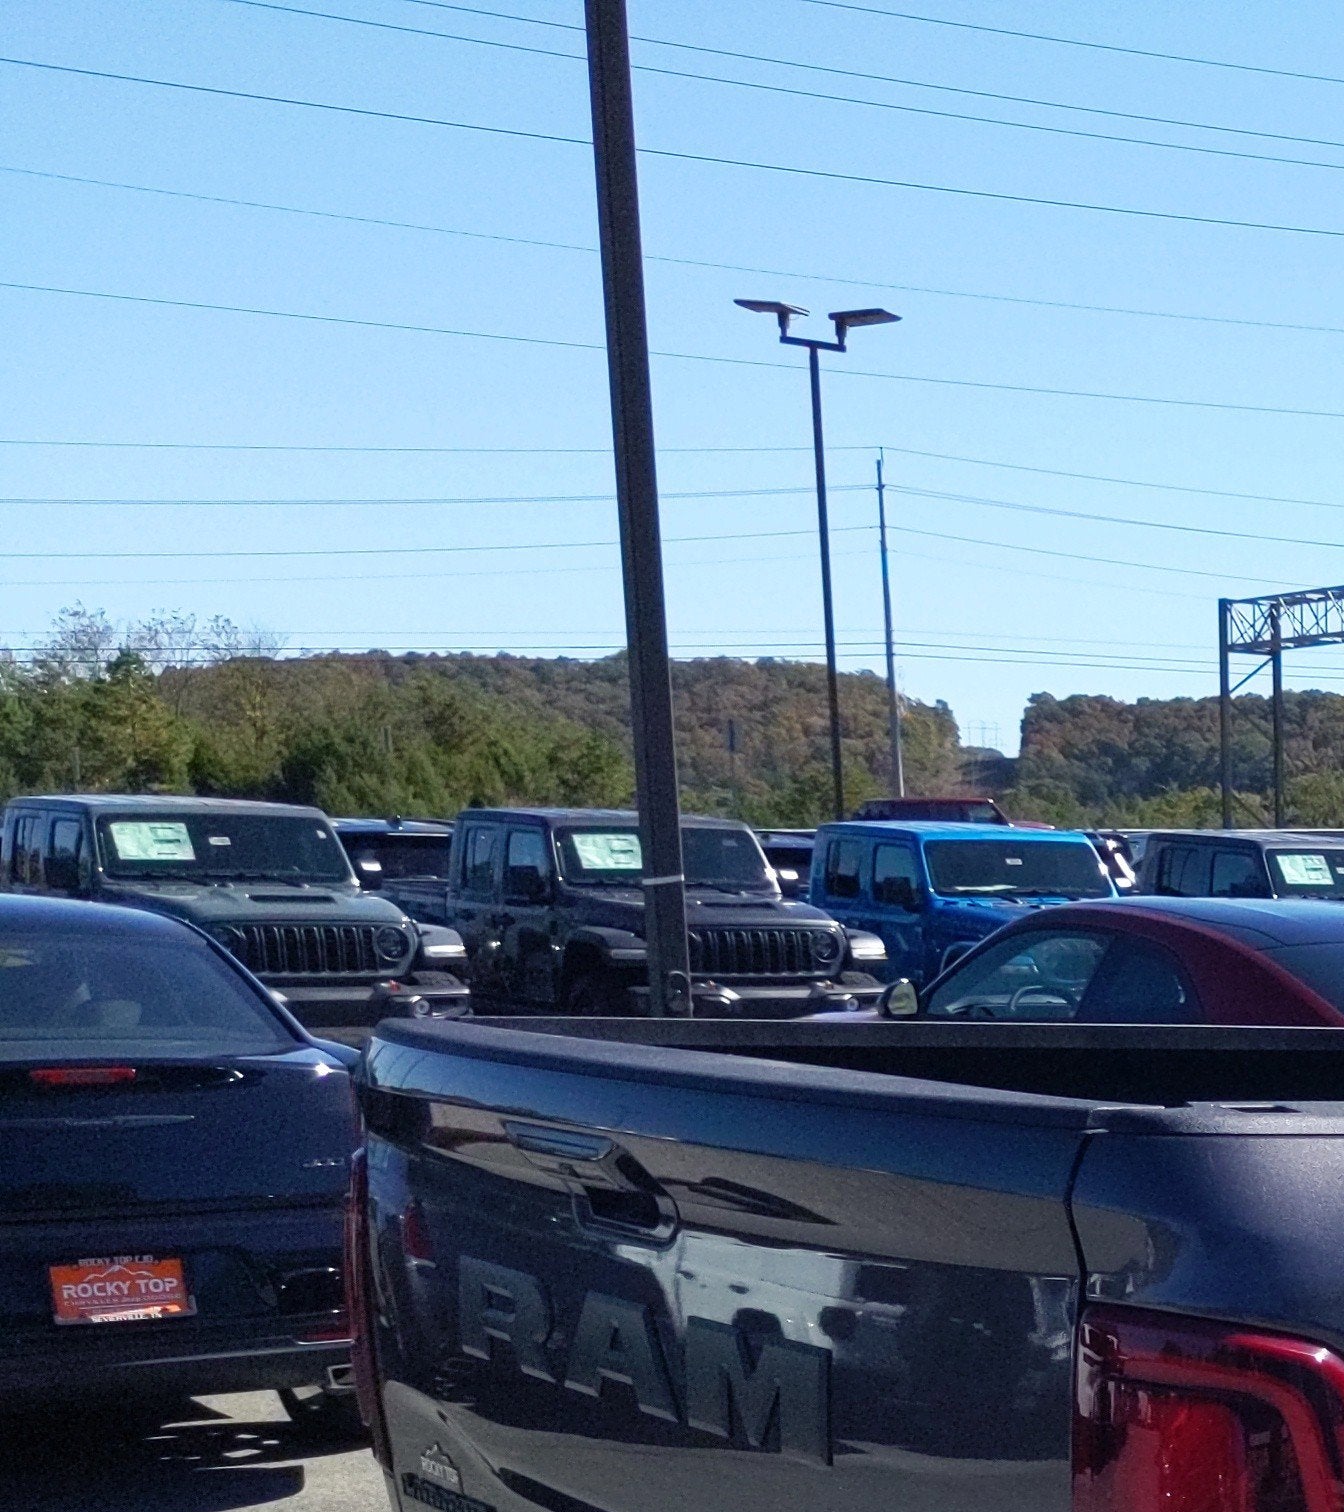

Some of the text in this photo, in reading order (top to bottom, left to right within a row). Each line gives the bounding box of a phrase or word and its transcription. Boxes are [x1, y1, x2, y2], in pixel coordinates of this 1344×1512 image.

[61, 1280, 132, 1300] ROCKY
[135, 1277, 179, 1294] TOP
[458, 1254, 833, 1466] RAM
